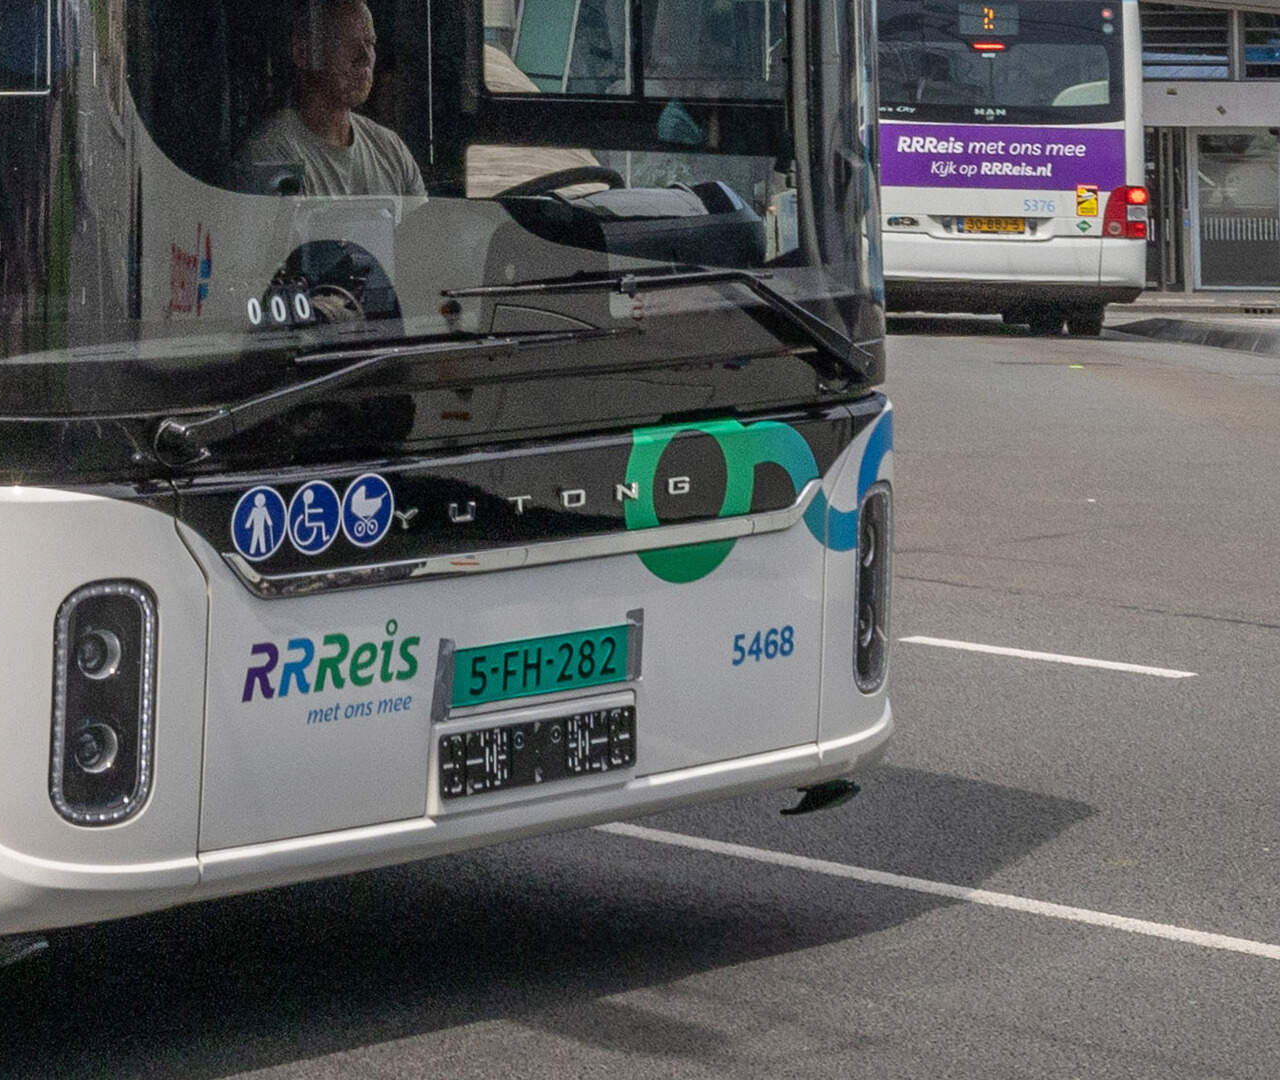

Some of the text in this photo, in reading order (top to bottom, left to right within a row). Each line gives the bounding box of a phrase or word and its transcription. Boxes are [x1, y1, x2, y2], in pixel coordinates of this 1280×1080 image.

[897, 136, 1086, 158] RRReis met ons mee
[931, 161, 1052, 179] Kijk op RRReis.nl
[1023, 200, 1055, 213] 5376
[395, 476, 691, 530] YUTONG
[241, 618, 421, 703] RRReis
[732, 625, 794, 667] 5468
[469, 636, 617, 696] 5-FH-282
[307, 695, 413, 724] met ons mee
